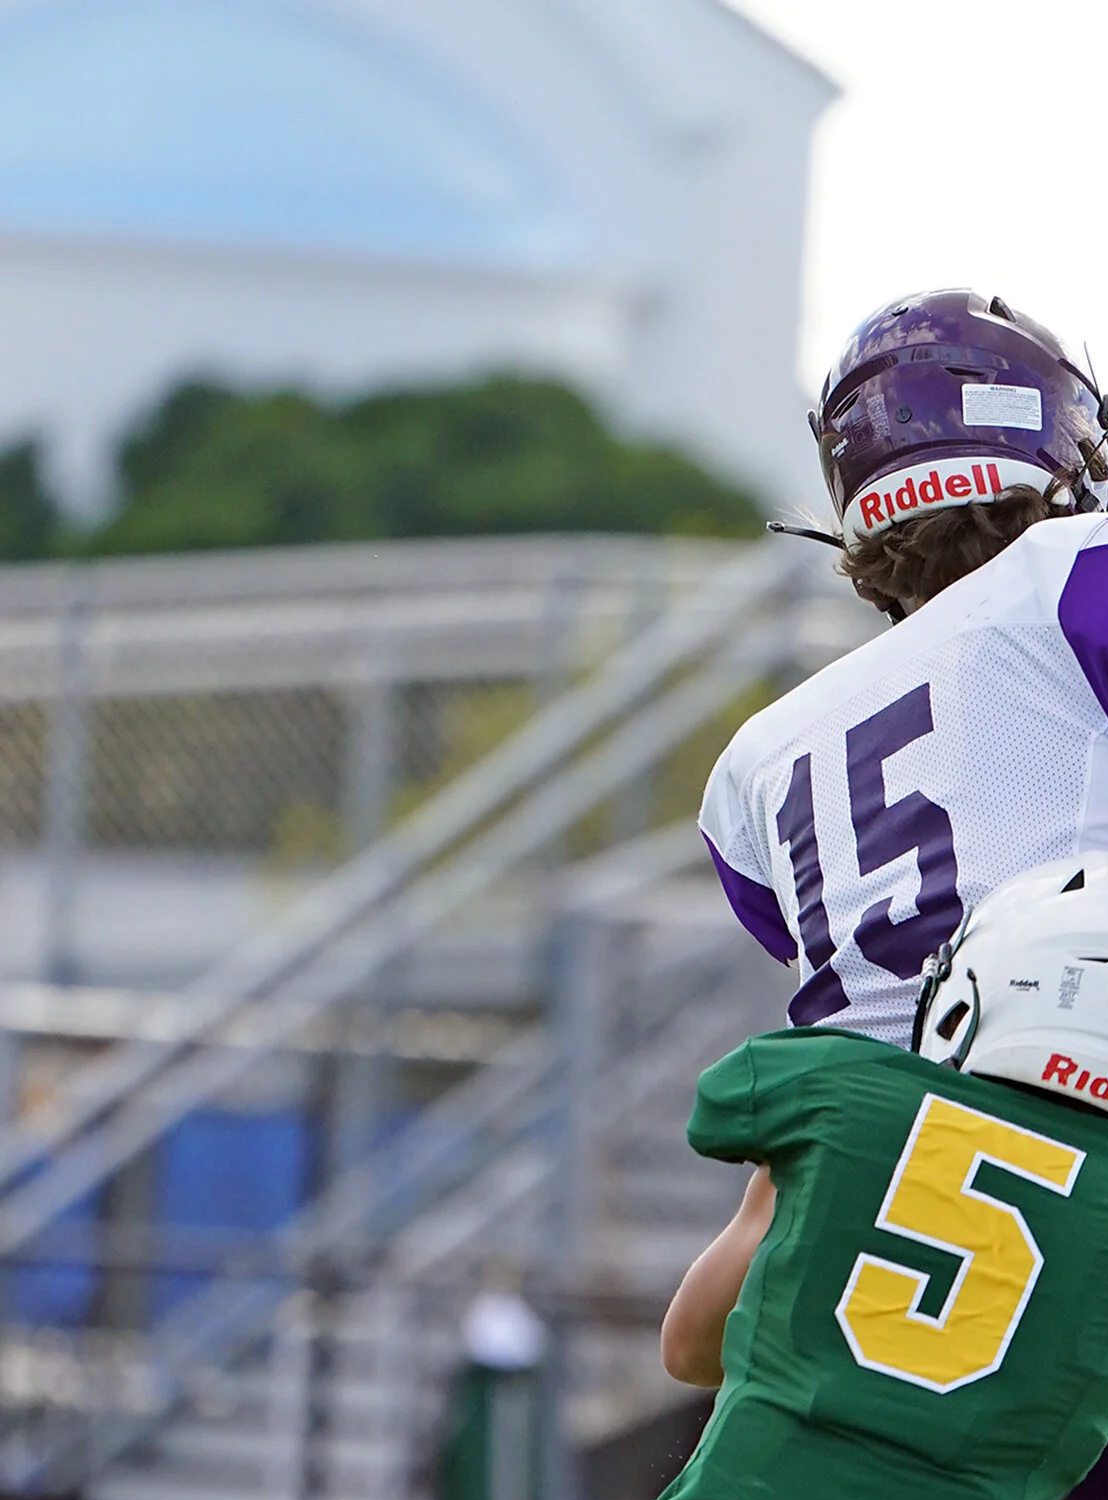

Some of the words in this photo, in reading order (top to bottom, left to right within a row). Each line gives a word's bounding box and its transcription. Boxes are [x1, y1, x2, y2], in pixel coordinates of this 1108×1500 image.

[859, 463, 1002, 530] Riddell
[775, 682, 964, 1027] 15
[834, 1092, 1087, 1395] 5
